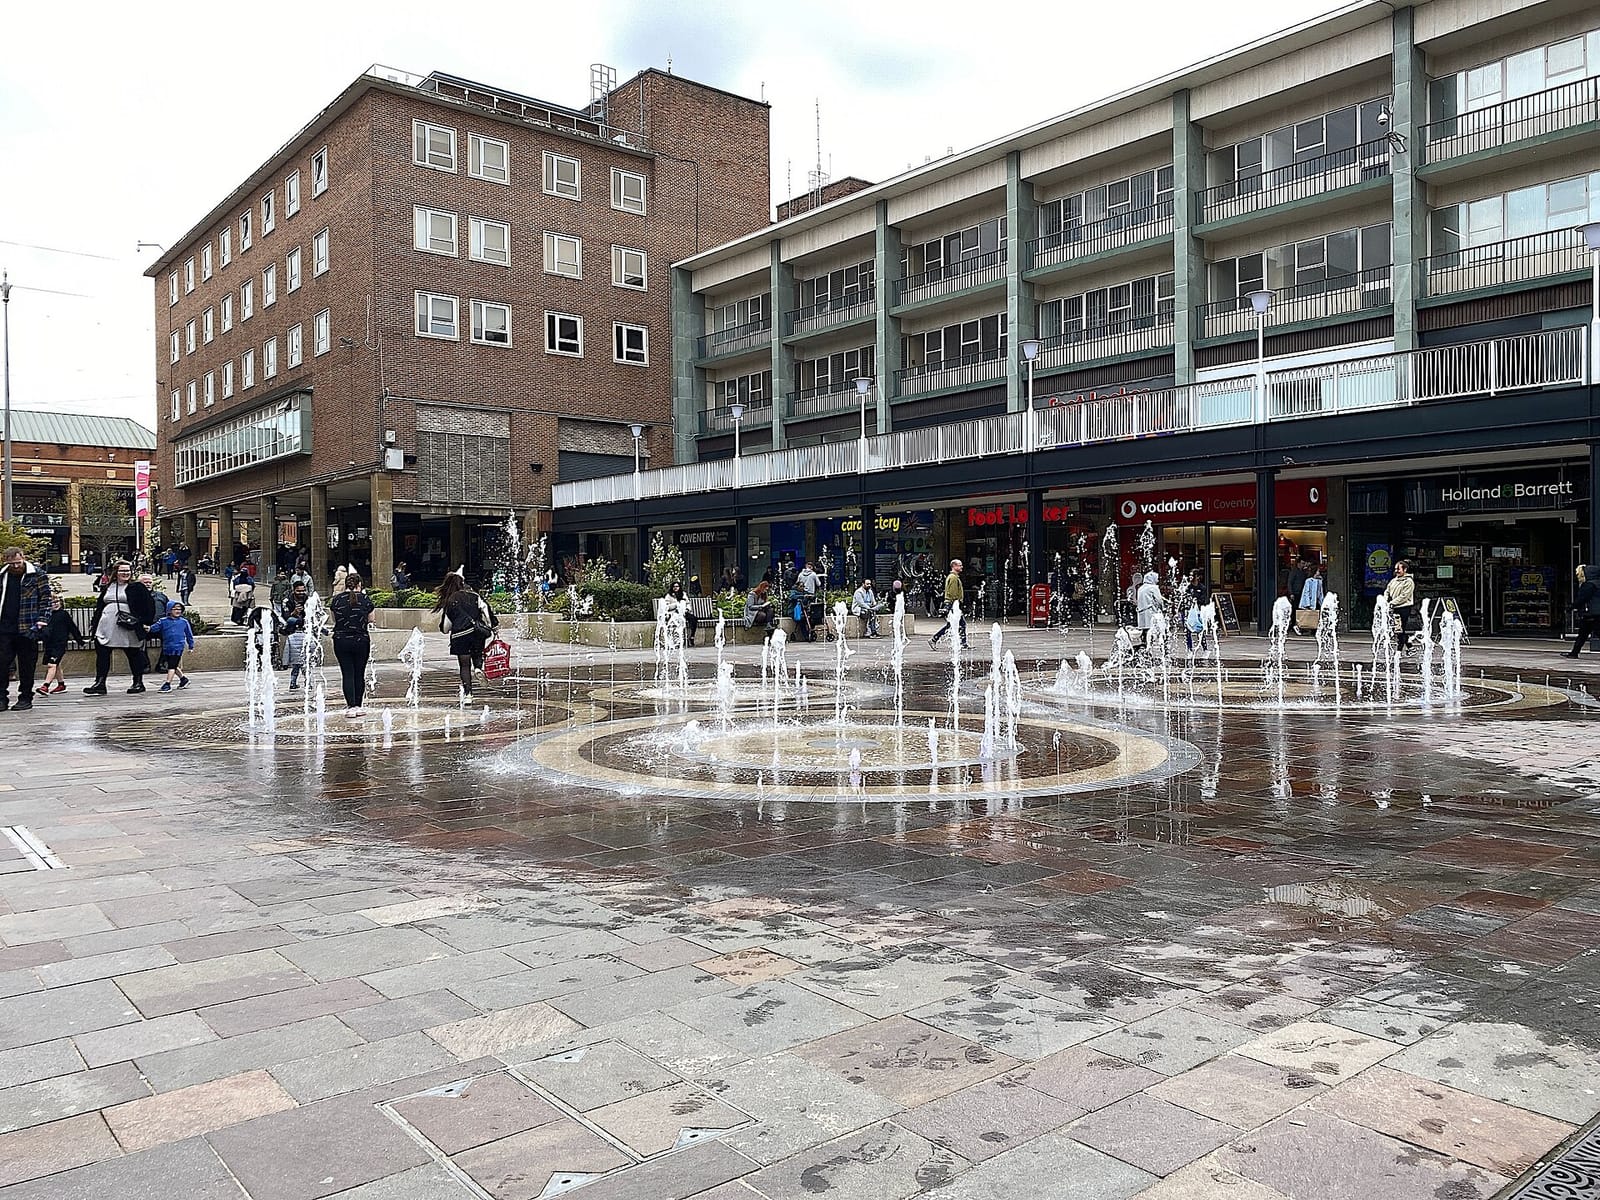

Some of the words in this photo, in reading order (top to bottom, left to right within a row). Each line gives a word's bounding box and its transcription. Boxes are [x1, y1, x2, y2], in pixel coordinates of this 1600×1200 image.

[1442, 485, 1501, 501] Holland
[1514, 481, 1573, 497] Barrett
[968, 507, 1004, 526] Foot
[1008, 504, 1069, 524] Loker
[1140, 499, 1203, 514] vodafone
[1213, 498, 1256, 510] Coventry
[680, 531, 715, 544] COVENTRY
